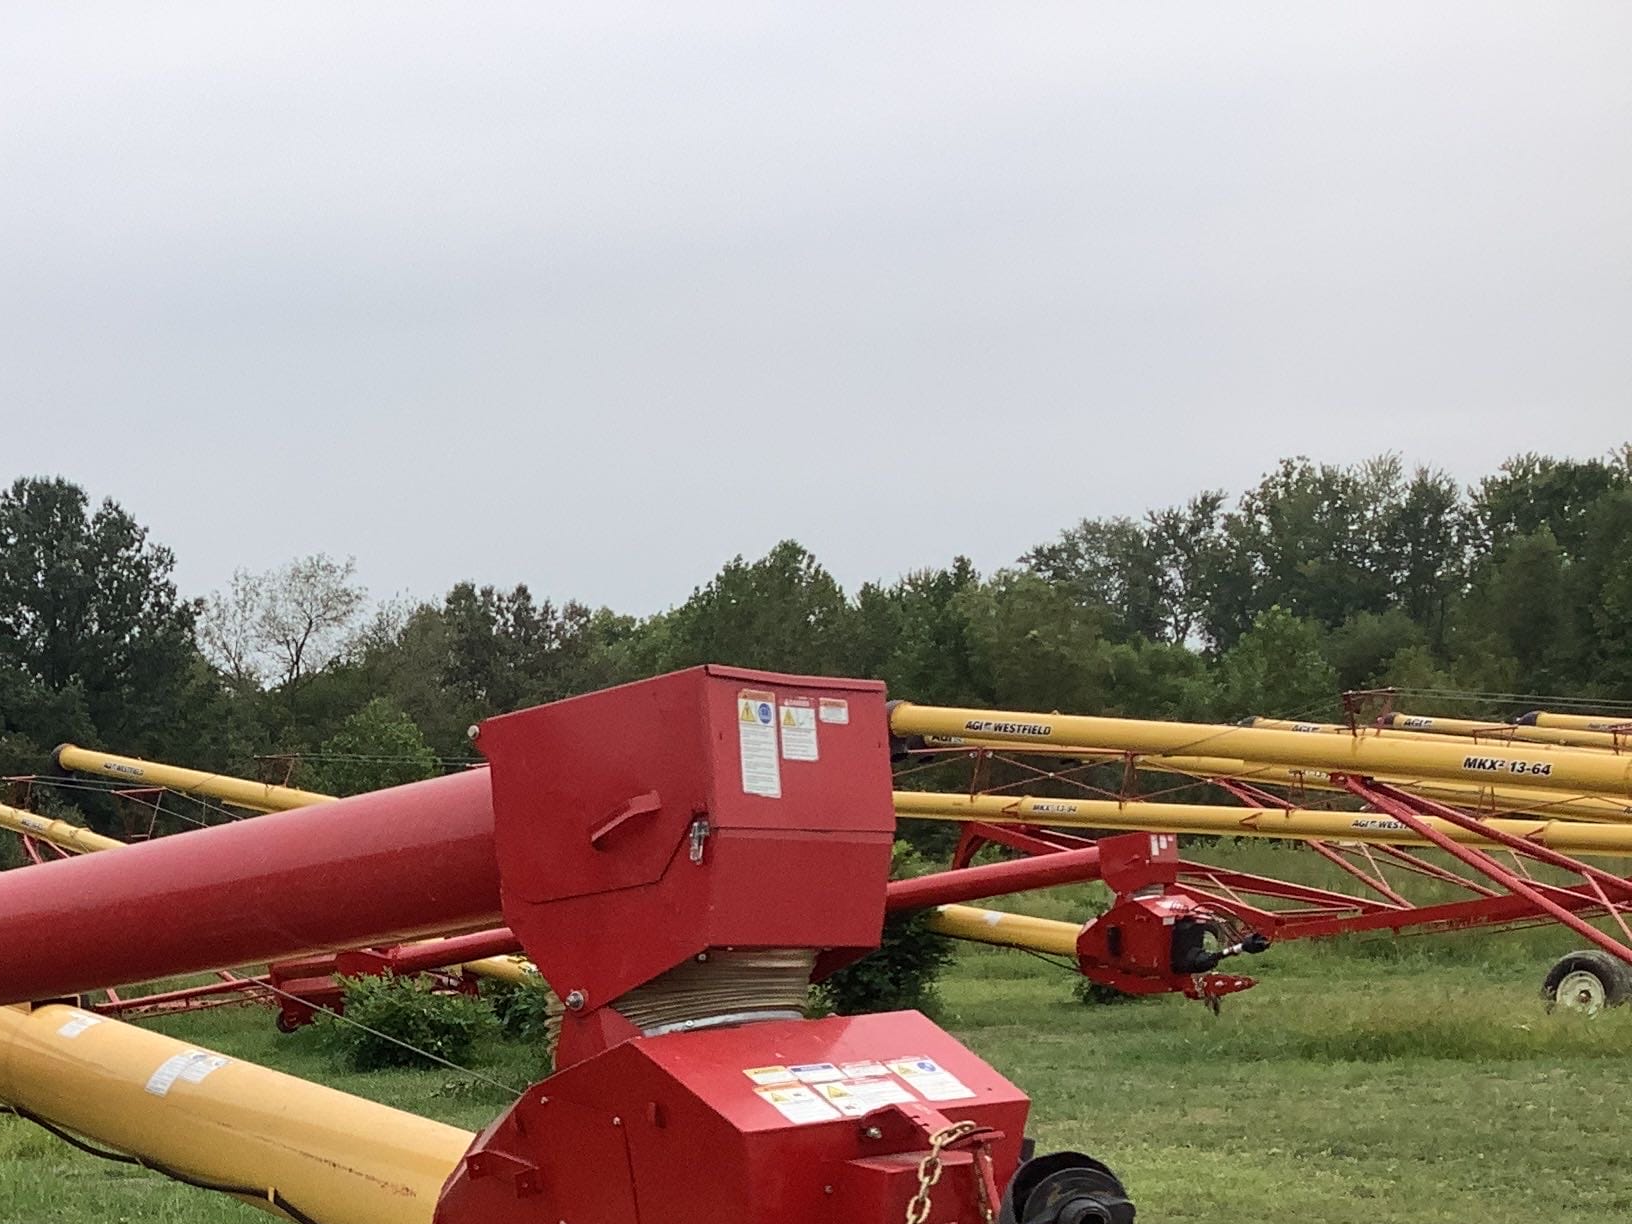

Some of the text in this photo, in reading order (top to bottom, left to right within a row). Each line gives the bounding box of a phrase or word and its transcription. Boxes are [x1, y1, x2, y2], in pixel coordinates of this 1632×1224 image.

[965, 721, 1052, 736] AGI WESTFIELD
[1510, 761, 1552, 775] 13-64
[1352, 819, 1369, 828] AGI
